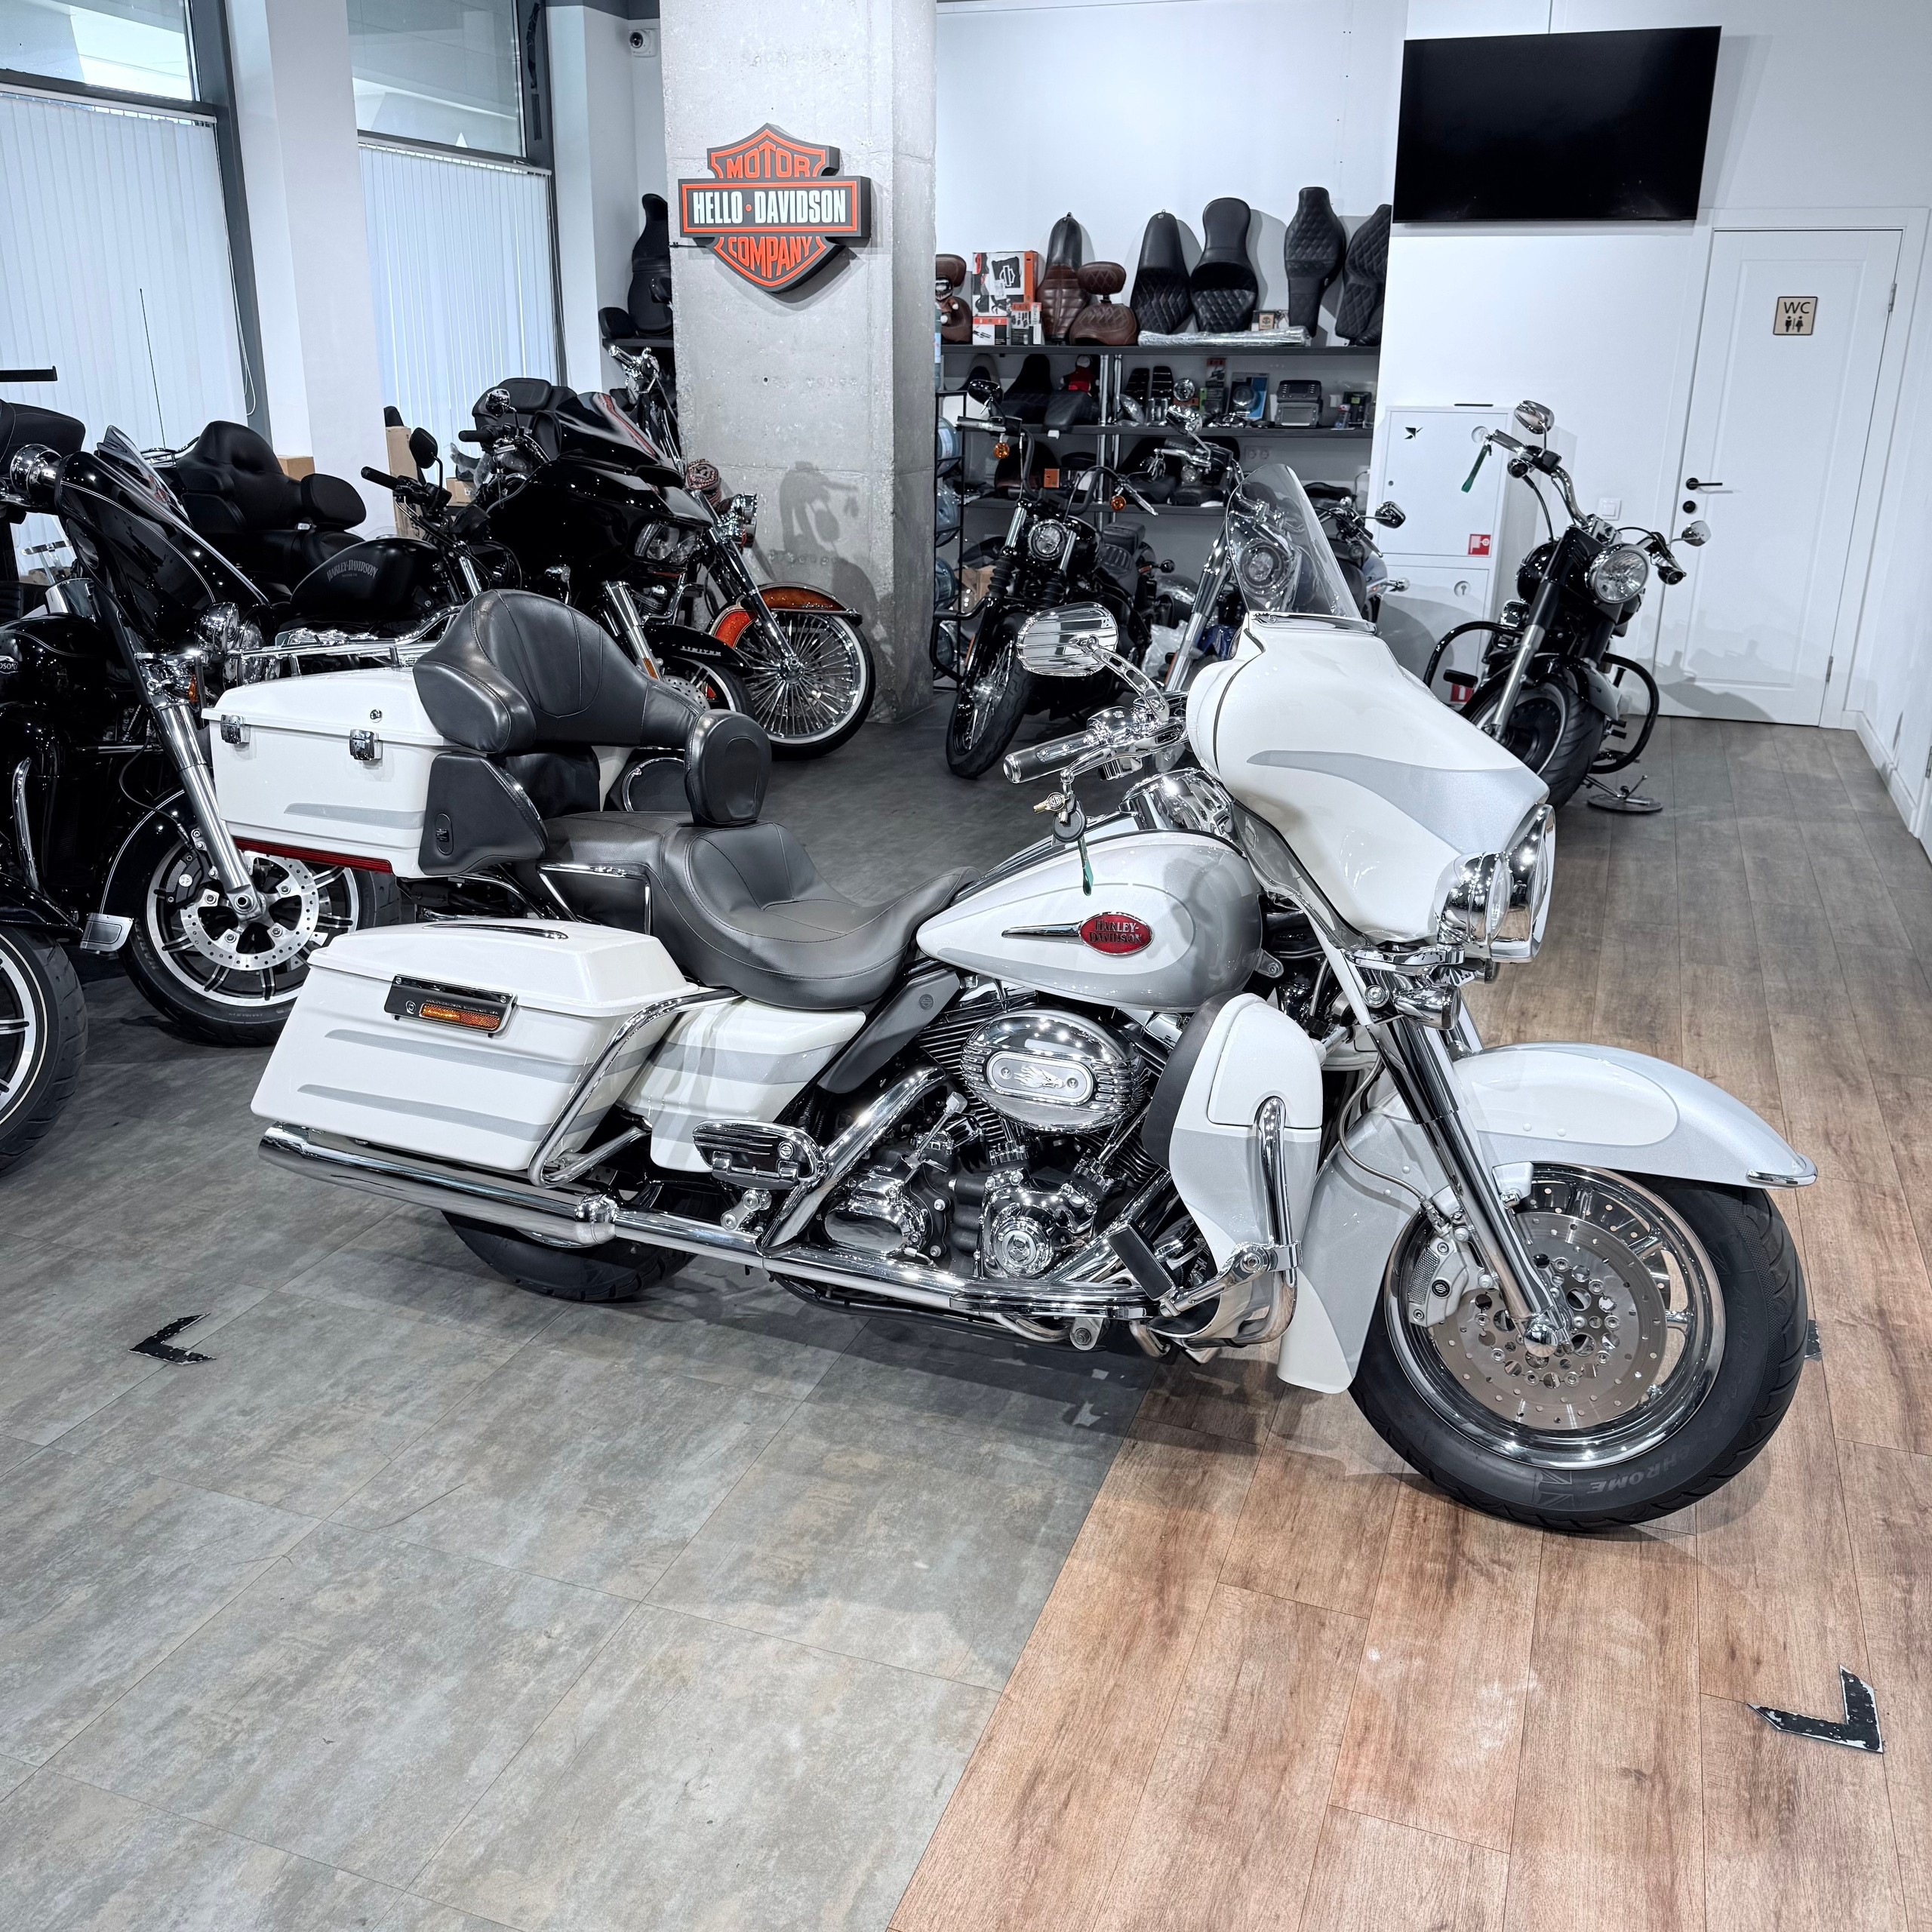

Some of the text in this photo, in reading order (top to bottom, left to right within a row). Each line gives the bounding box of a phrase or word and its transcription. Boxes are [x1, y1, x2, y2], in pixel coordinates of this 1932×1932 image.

[726, 140, 811, 179] MOTOR
[693, 189, 846, 224] HELLO DAVIDSON
[728, 236, 812, 278] COMPANY
[1783, 301, 1811, 314] WC
[1088, 931, 1143, 944] DAVIDSON
[1094, 918, 1140, 934] HARLEY-
[1586, 1444, 1691, 1495] CHROME
